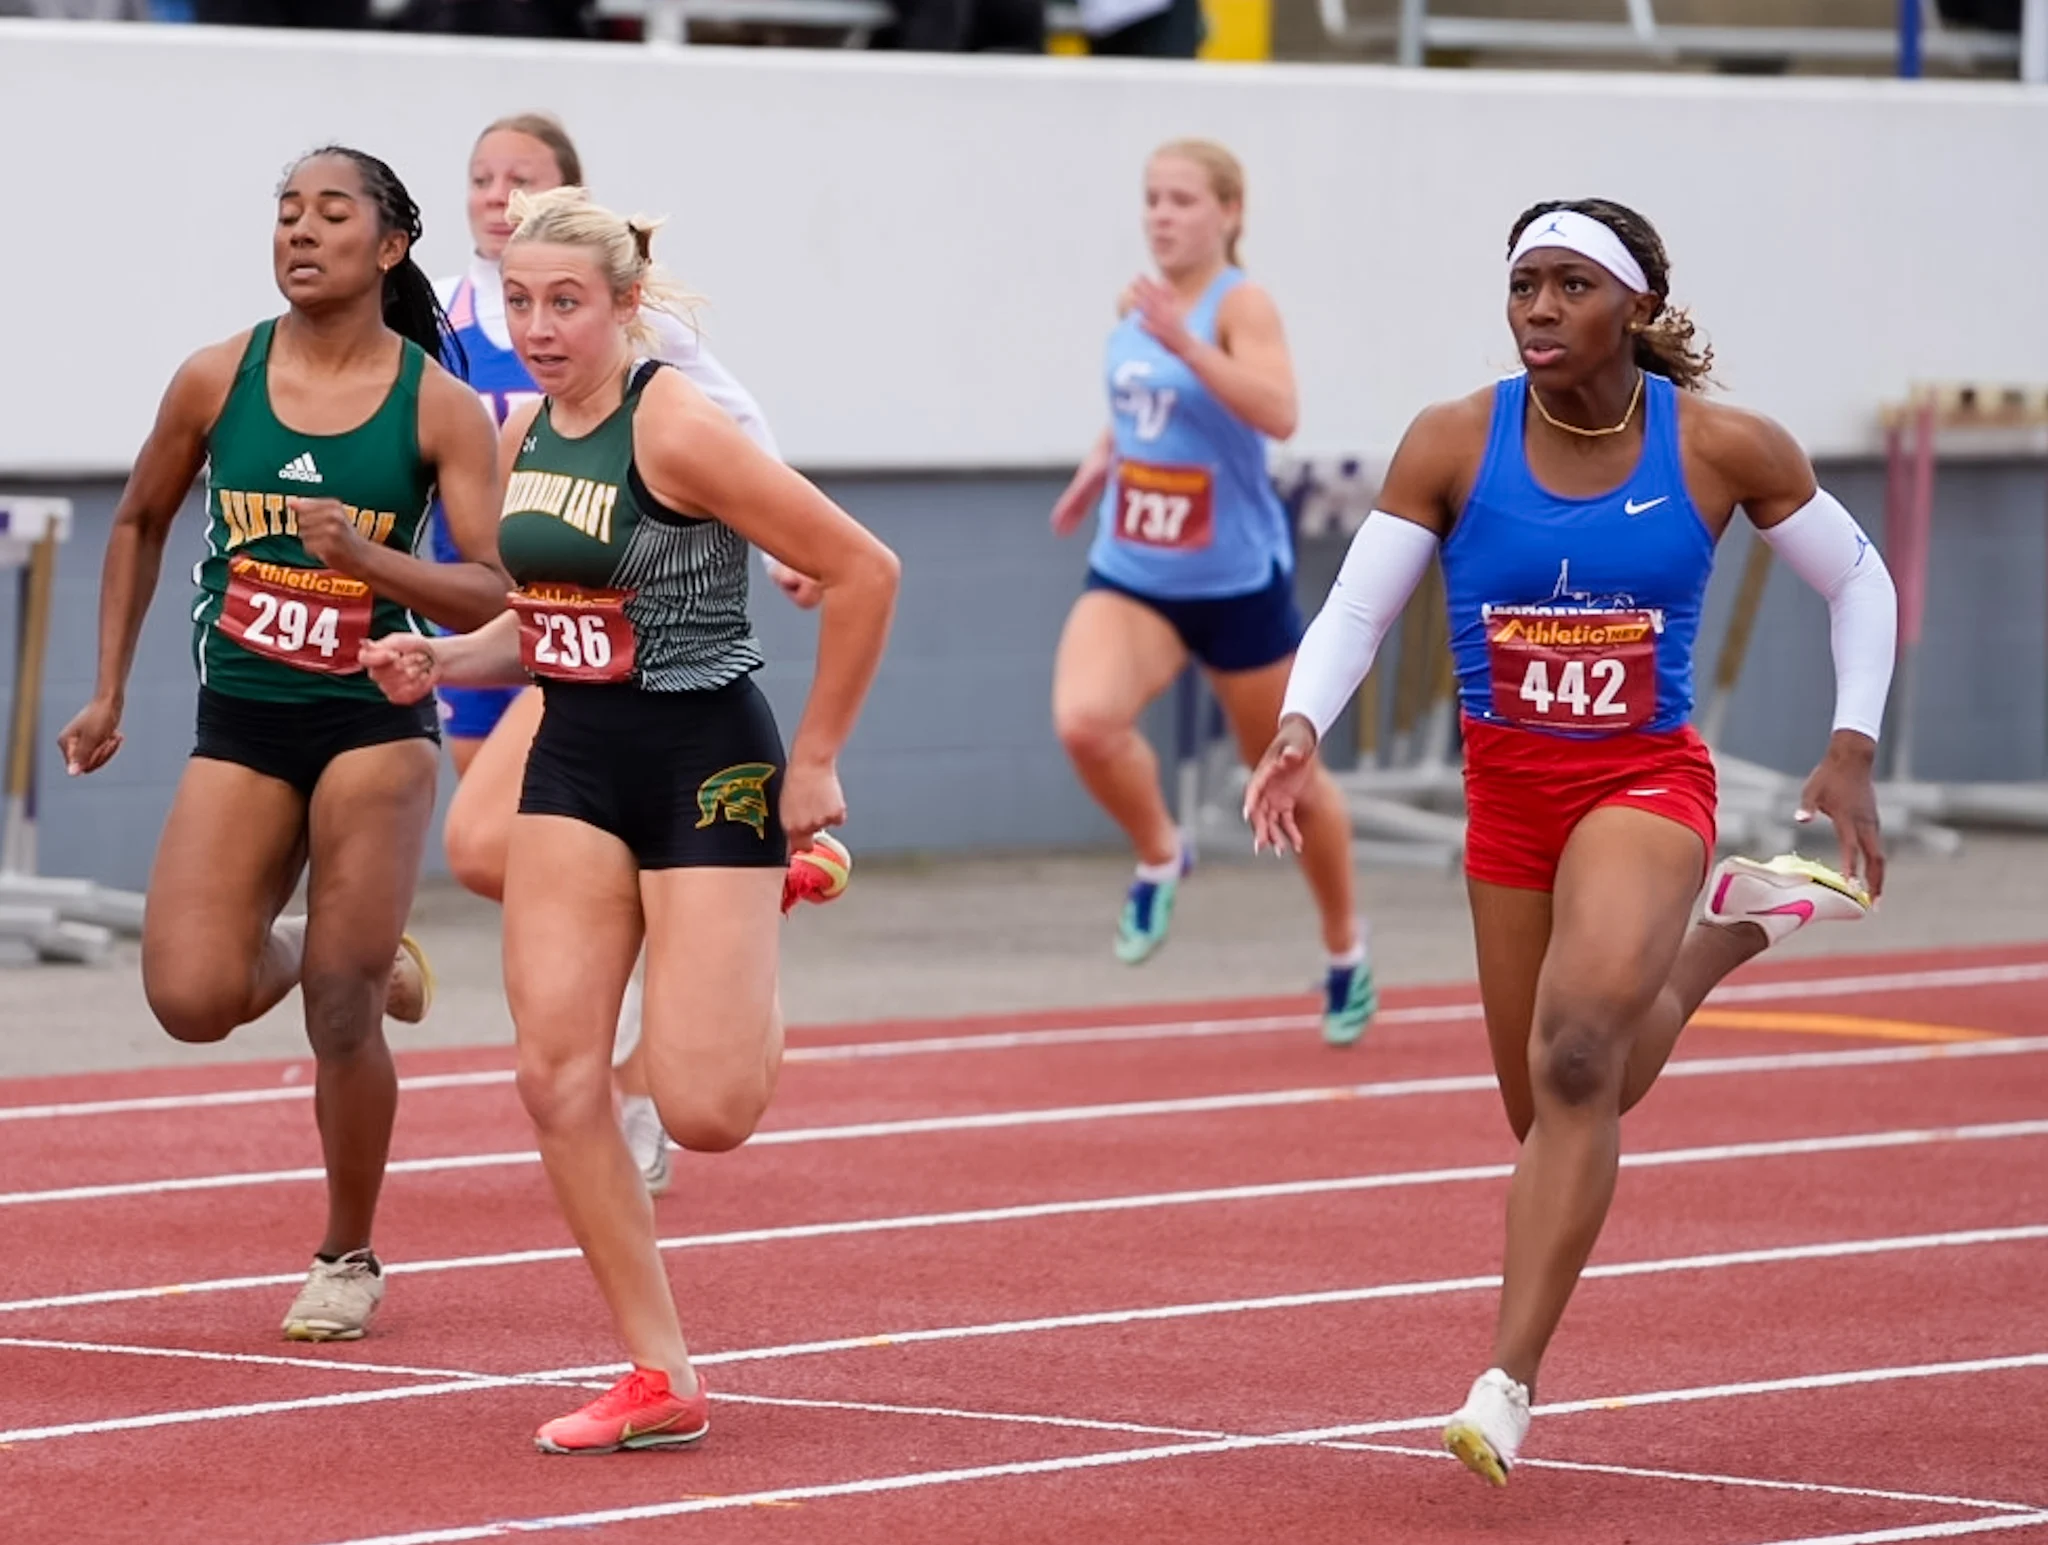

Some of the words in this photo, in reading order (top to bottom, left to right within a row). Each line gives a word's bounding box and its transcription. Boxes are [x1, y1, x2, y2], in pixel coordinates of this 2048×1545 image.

[278, 468, 323, 484] adidas
[1124, 487, 1192, 541] 737
[232, 557, 331, 593] Athletic
[243, 592, 340, 657] 294
[533, 612, 611, 668] 236
[1492, 618, 1606, 645] Athletic
[1520, 658, 1627, 716] 442
